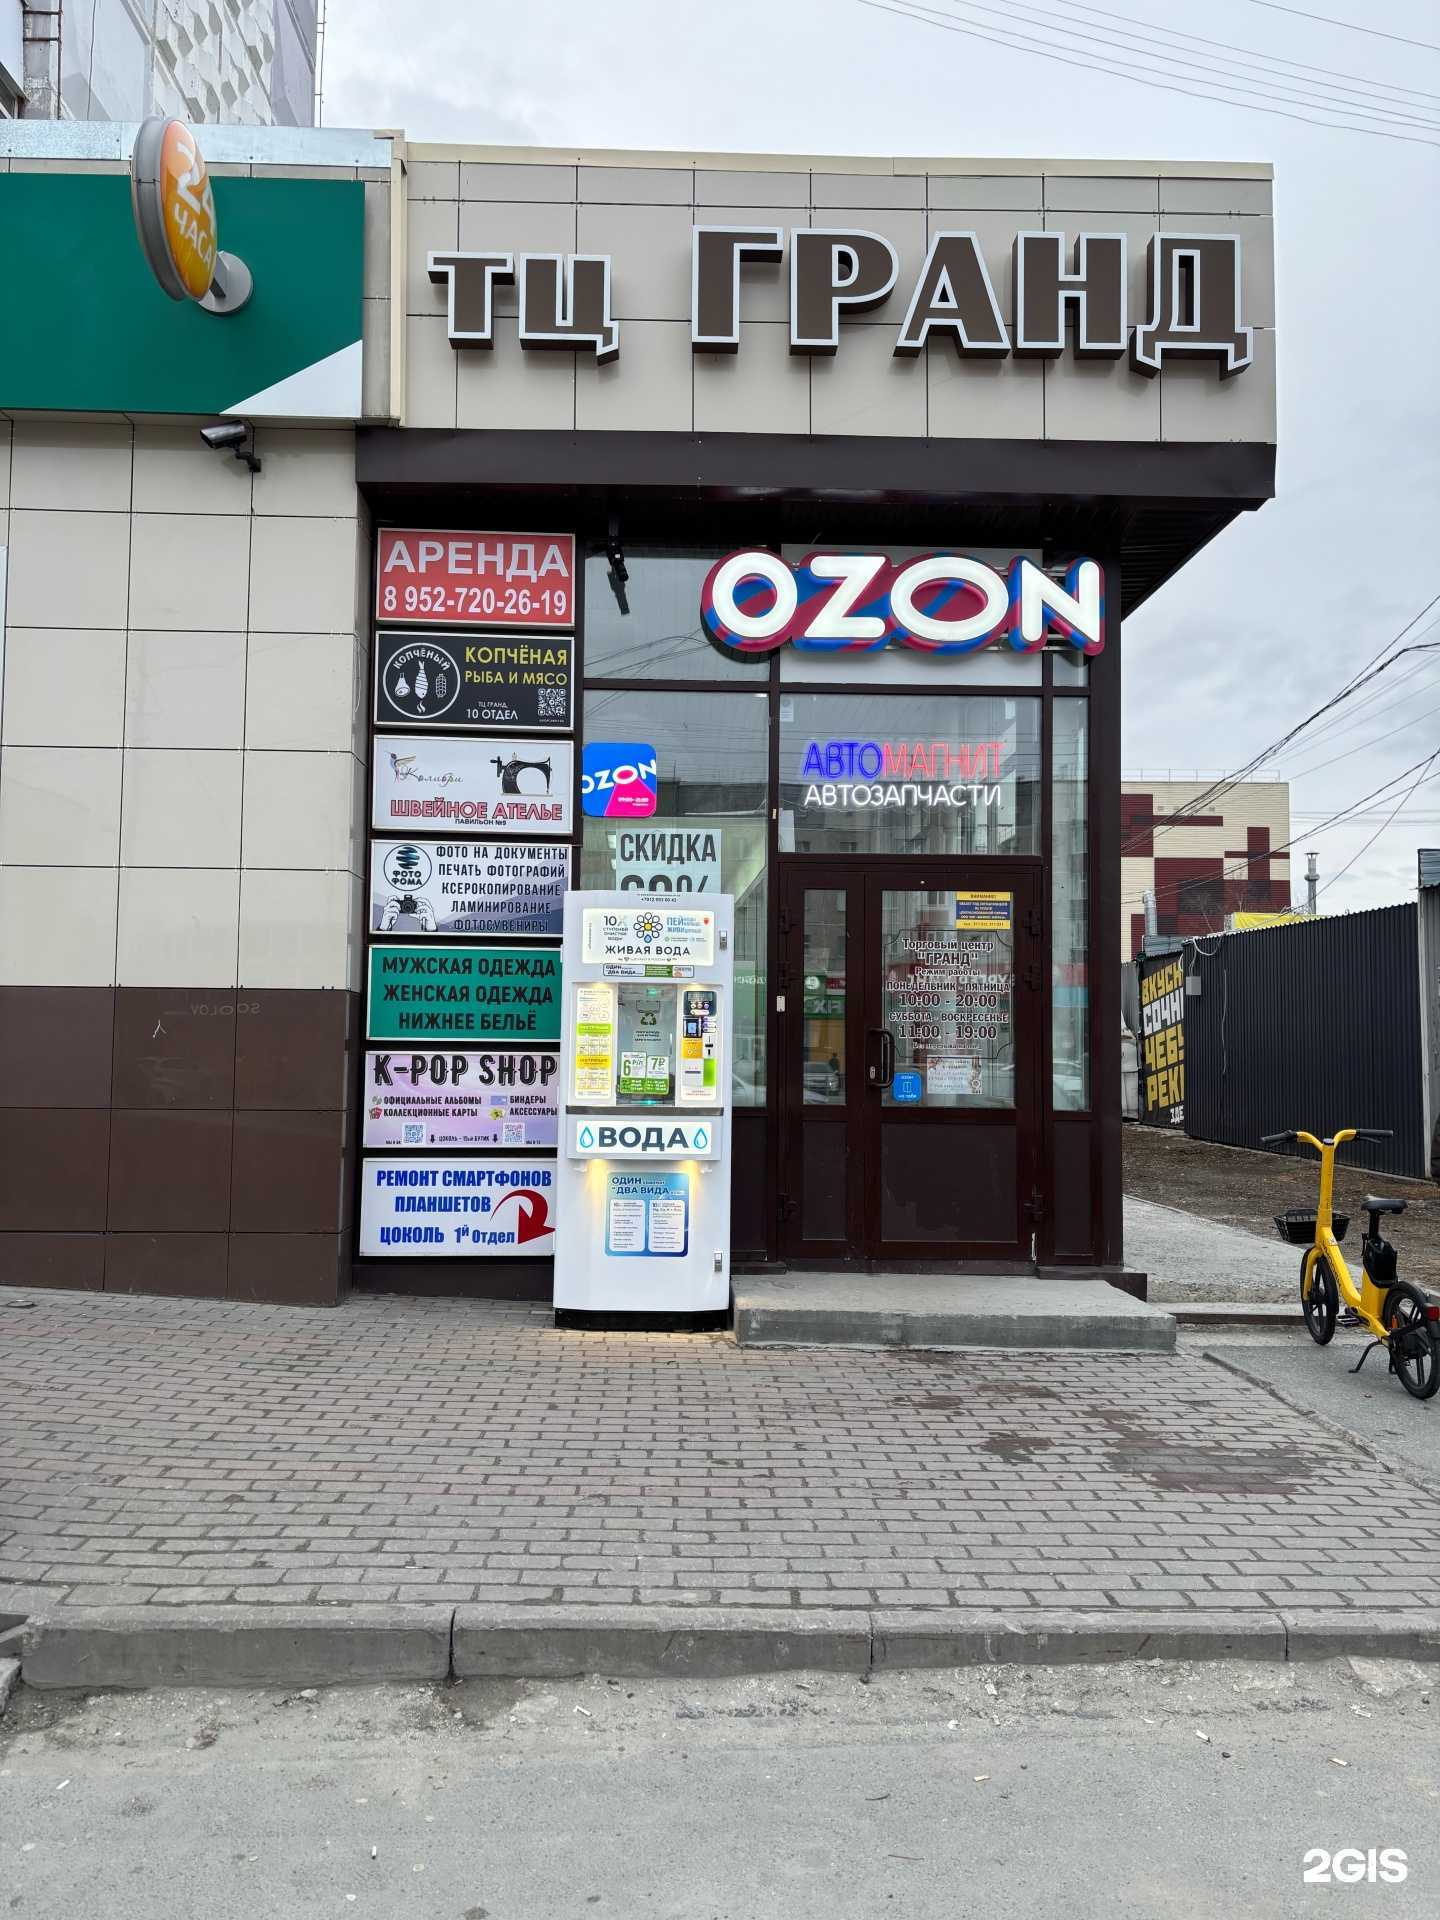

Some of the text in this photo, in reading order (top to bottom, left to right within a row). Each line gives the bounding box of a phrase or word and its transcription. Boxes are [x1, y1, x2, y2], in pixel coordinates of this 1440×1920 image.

[174, 203, 212, 269] ЧАСА
[427, 225, 1253, 374] ТЦ ГРАНД
[384, 540, 569, 583] АРЕНДА
[384, 585, 567, 615] 8 952-720-26-19
[704, 549, 1104, 652] OZON
[465, 645, 567, 666] КОПЧЁНАЯ
[465, 670, 568, 686] РЫБА И МЯСО
[466, 708, 519, 720] 10 ОТДЕЛ
[803, 741, 1006, 779] АВТОМАГНИТ
[582, 760, 656, 794] OZON
[804, 784, 1002, 807] АВТОЗАПЧАСТИ
[390, 797, 563, 821] ШВЕЙНОЕ АТЕЛЬЕ
[455, 818, 494, 826] ПАВИЛЬОН
[436, 846, 568, 860] ФОТО НА ДОКУМЕНТЫ
[620, 833, 717, 865] СКИДКА
[393, 870, 422, 878] ФОТО
[438, 863, 565, 878] ПЕЧАТЬ ФОТОГРАФИЙ
[391, 877, 422, 886] ФОМА
[441, 882, 561, 896] КСЕРОКОПИРОВАНИЕ
[450, 901, 551, 914] ЛАМИНИРОВАНИЕ
[454, 919, 548, 932] ФОТОСУВЕНИРЫ
[605, 945, 691, 957] ЖИВАЯ ВОДА
[902, 938, 994, 953] Торговый центр
[917, 952, 979, 967] "ГРАНД"
[382, 957, 556, 978] МУЖСКАЯ ОДЕЖДА
[915, 967, 980, 978] Режим работы
[383, 984, 553, 1005] ЖЕНСКАЯ ОДЕЖДА
[887, 981, 957, 992] ПОНЕДЕЛЬНИК
[964, 983, 1011, 994] ПЯТНИЦА
[899, 994, 941, 1007] 10:00
[955, 994, 997, 1008] 20:00
[399, 1010, 537, 1031] НИЖНЕЕ БЕЛЬЁ
[889, 1012, 1009, 1023] СУББОТА ВОСКРЕСЕНЬЕ
[899, 1026, 941, 1039] 11:00
[955, 1026, 997, 1039] 19:00
[374, 1055, 469, 1086] K-POP
[478, 1055, 557, 1086] SHOP
[623, 1059, 631, 1076] 6
[383, 1095, 482, 1105] ОФИЦИАЛЬНЫЕ АЛЬБОМЫ
[509, 1095, 546, 1105] БИНДЕРЫ
[383, 1108, 478, 1118] КОЛЛЕКЦИОННЫЕ КАРТЫ
[509, 1107, 558, 1116] АКСЕССУАРЫ
[598, 1126, 690, 1151] ВОДА
[377, 1170, 552, 1187] РЕМОНТ СМАРТФОНОВ
[612, 1177, 642, 1186] ОДИН
[616, 1187, 638, 1195] ДВА
[640, 1186, 670, 1196] ВИДА
[395, 1196, 492, 1213] ПЛАНШЕТОВ
[380, 1226, 445, 1245] ЦОКОЛЬ
[472, 1229, 515, 1245] Отдел
